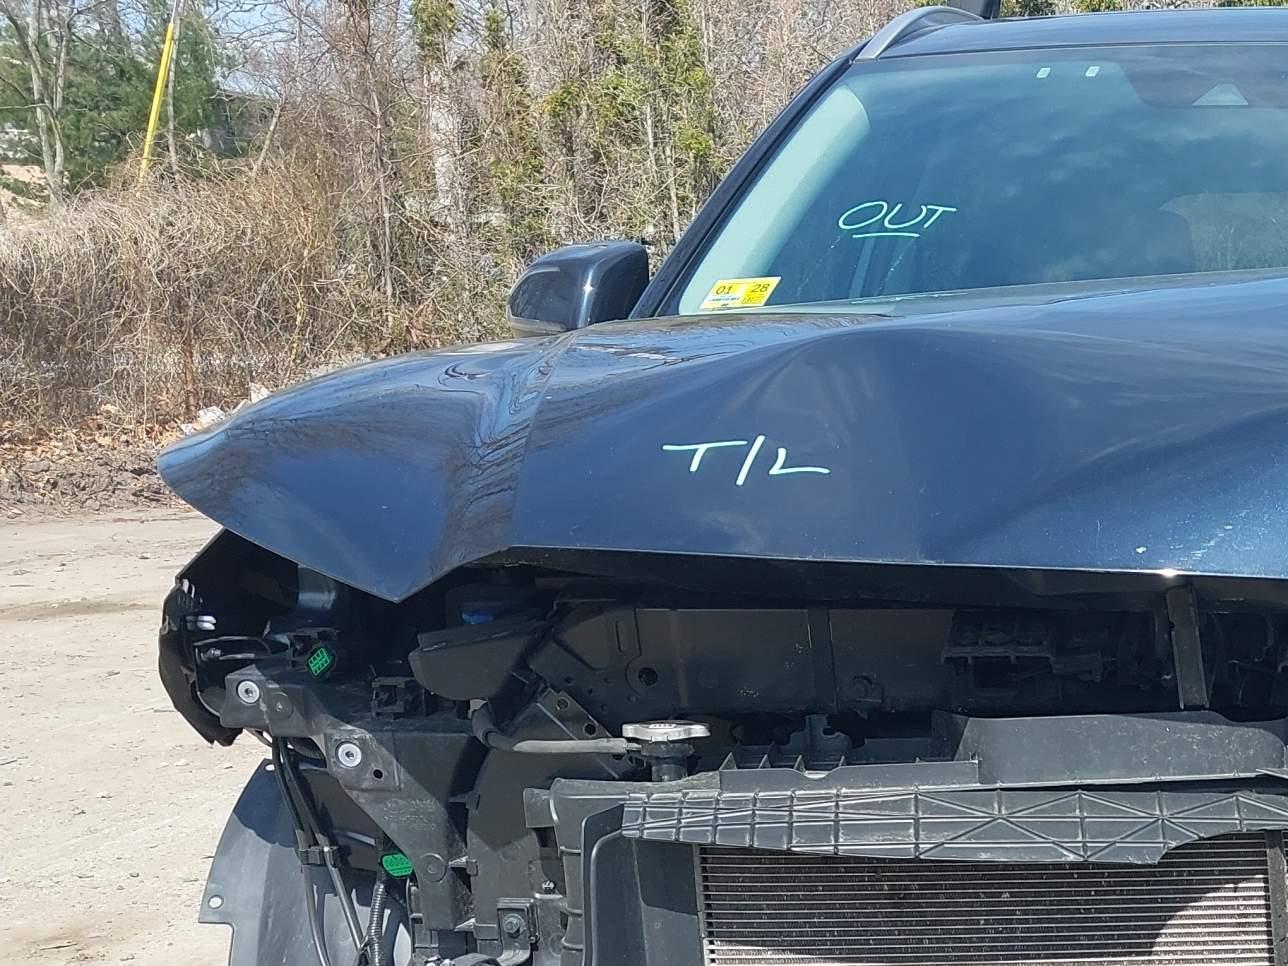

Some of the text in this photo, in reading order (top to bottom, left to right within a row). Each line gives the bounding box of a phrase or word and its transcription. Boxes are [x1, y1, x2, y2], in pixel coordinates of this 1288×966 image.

[838, 200, 958, 230] OUT
[715, 283, 770, 295] 01 28
[662, 434, 831, 486] T/L
